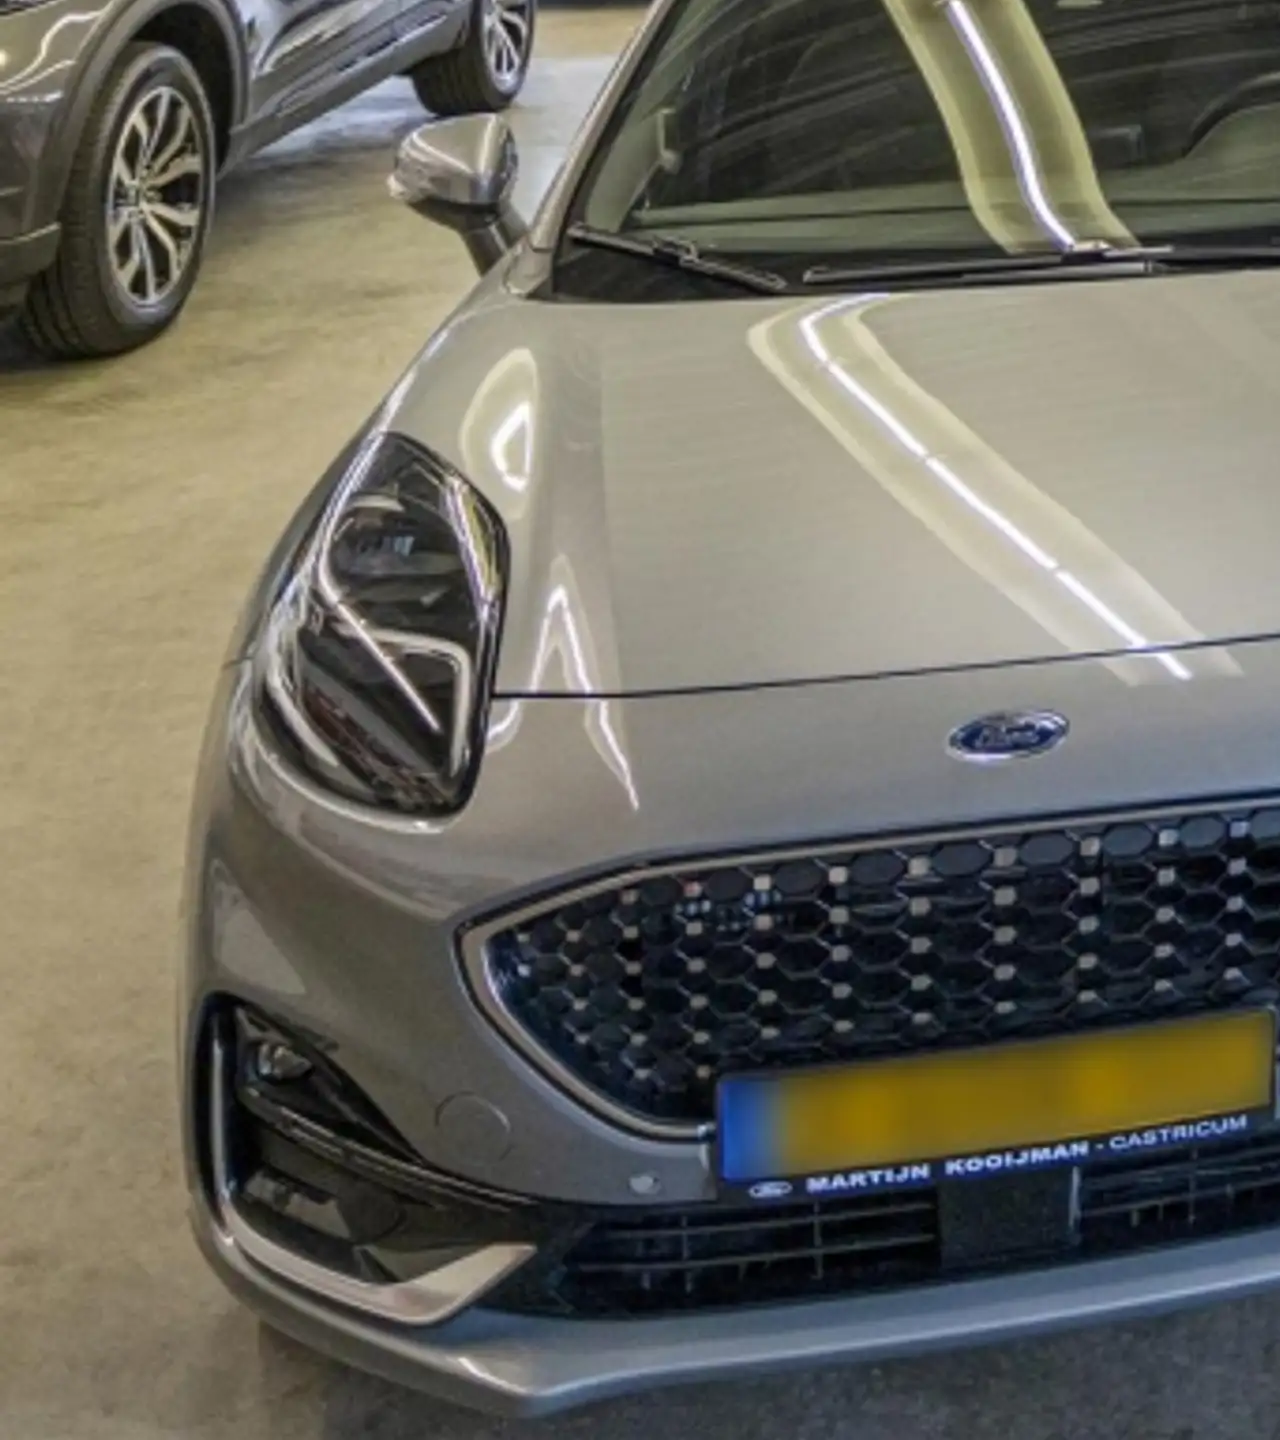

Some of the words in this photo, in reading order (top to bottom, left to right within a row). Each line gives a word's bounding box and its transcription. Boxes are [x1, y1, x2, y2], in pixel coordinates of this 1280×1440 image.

[806, 1163, 930, 1193] MARTIJN
[945, 1140, 1089, 1176] KOOIJMAN
[1109, 1114, 1248, 1150] CASTRICUM
